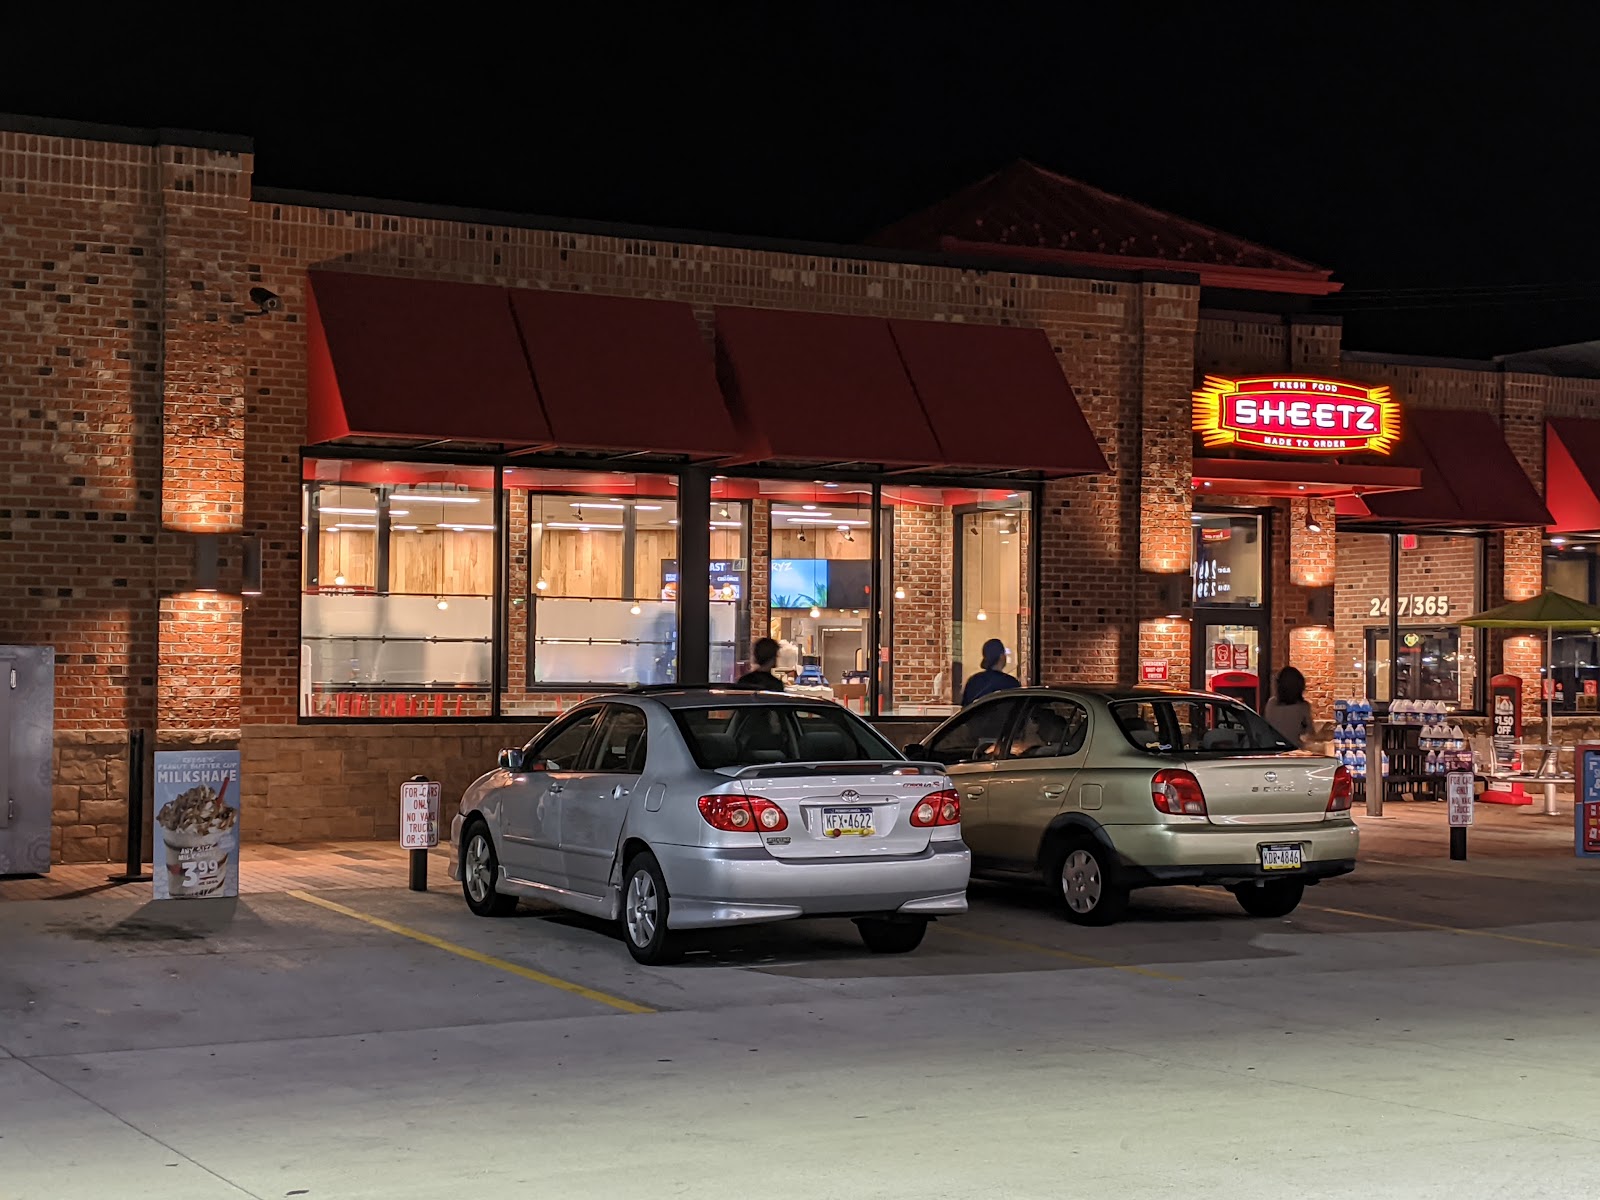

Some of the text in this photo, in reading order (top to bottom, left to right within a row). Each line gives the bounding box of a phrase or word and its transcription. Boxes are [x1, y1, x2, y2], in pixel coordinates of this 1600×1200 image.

[1272, 381, 1338, 392] FRESH FOOD
[1235, 399, 1375, 430] SHEETZ
[1263, 436, 1346, 448] MADE TO ORDER
[771, 562, 793, 571] RYZ
[1495, 716, 1514, 726] $1.50
[1496, 726, 1511, 735] OFF
[157, 769, 237, 783] MILKSHAKE
[404, 786, 438, 798] FOR CARS
[413, 799, 431, 810] ONLY
[406, 811, 435, 822] NO VANS
[409, 823, 433, 833] TRUCKS
[406, 834, 416, 844] OR
[180, 847, 194, 855] ANY
